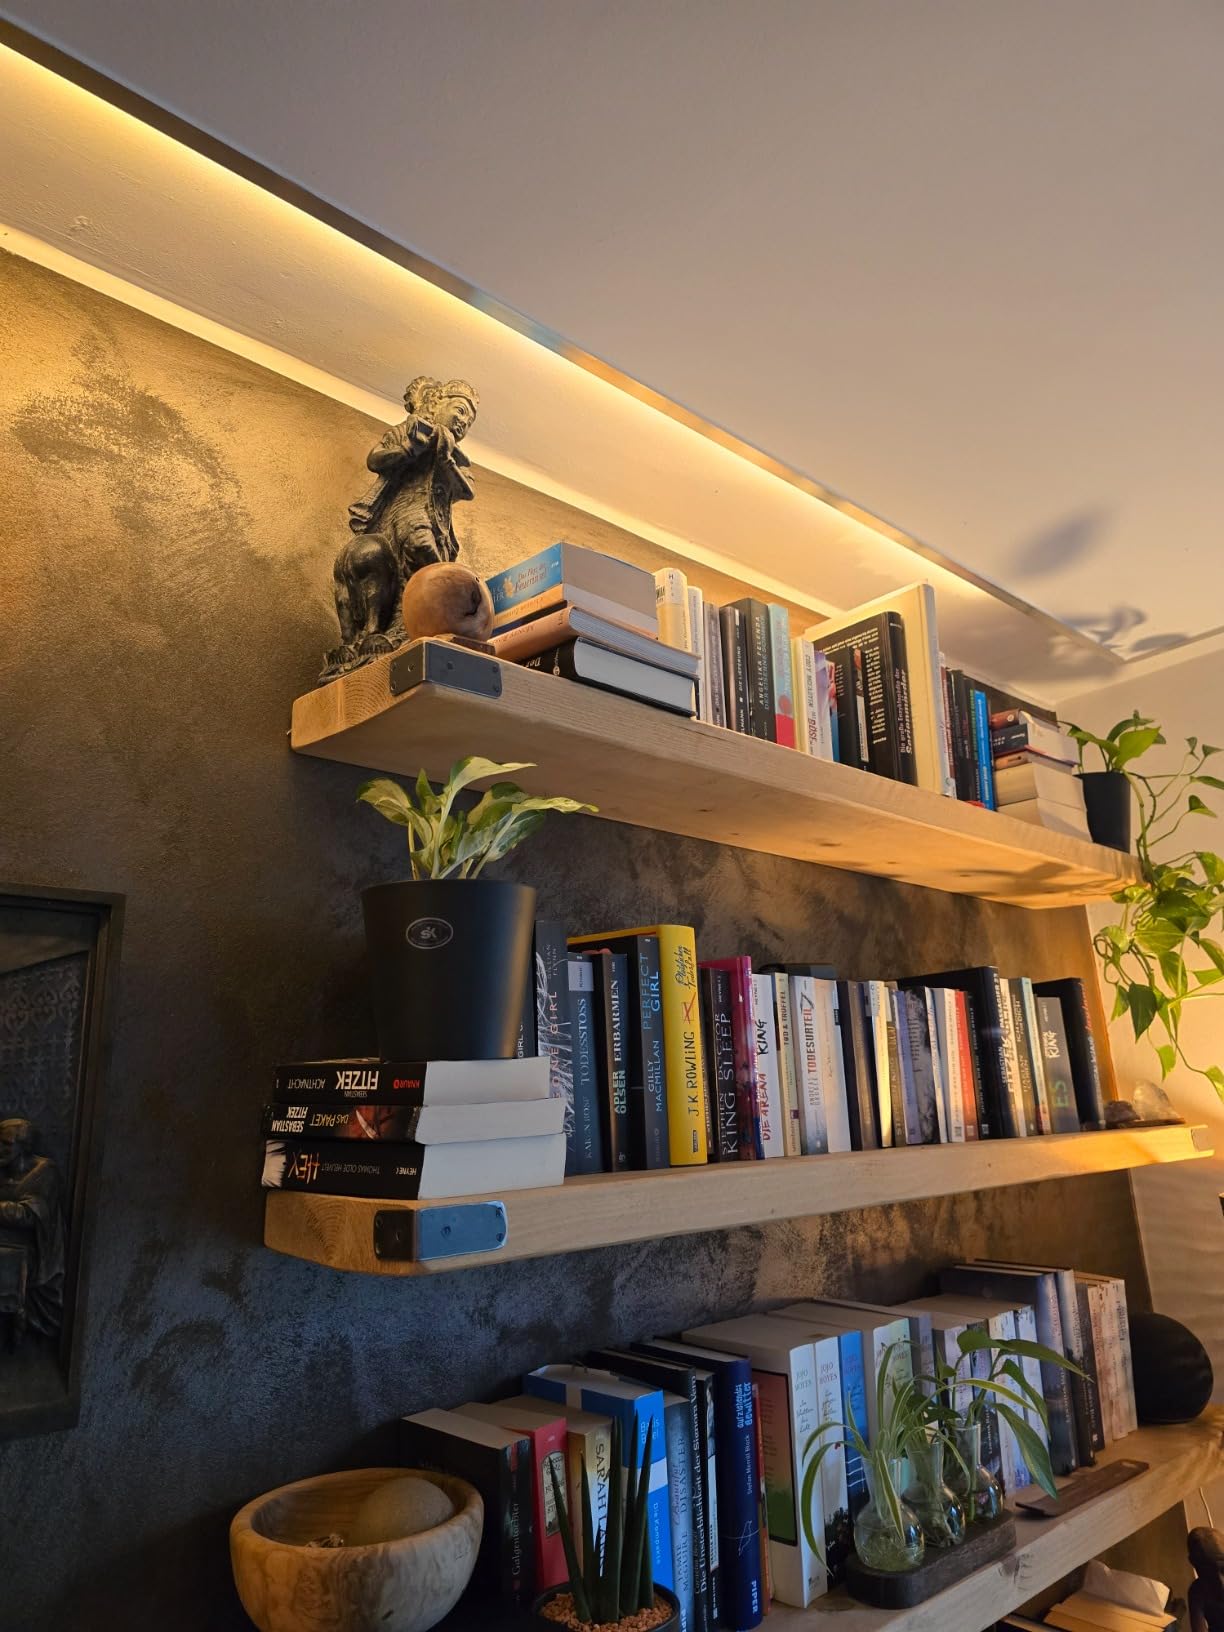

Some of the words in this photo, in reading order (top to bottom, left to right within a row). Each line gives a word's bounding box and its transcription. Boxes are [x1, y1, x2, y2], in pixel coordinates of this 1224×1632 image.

[756, 660, 764, 705] ANGELIKA
[901, 669, 912, 754] Serienmörder
[548, 991, 559, 1034] GIRL
[639, 952, 652, 1030] PERFECT
[650, 971, 660, 1012] GIRL
[994, 984, 1005, 1028] PASSAGIER
[577, 998, 590, 1085] TODESSTOSS
[610, 980, 622, 1061] ERBARMEN
[755, 1019, 769, 1055] KING
[803, 1008, 817, 1074] TODESURTEIL
[715, 1013, 724, 1080] DOCTOR
[720, 1013, 734, 1081] SLEEP
[997, 1046, 1006, 1084] SEBASTIAN
[1046, 1031, 1060, 1058] KING
[287, 1078, 325, 1089] ACHTNACHT
[335, 1070, 380, 1090] FITZEK
[618, 1070, 626, 1114] OLSEN
[647, 1061, 655, 1092] GILLY
[652, 1039, 663, 1112] MACMILLAN
[1049, 1080, 1070, 1108] ES
[271, 1120, 304, 1133] SEBASTIAN
[287, 1107, 308, 1118] FITZEK
[309, 1113, 336, 1127] PAKET
[335, 1114, 349, 1124] DAS
[719, 1092, 727, 1156] STEPHEN
[724, 1092, 739, 1154] KING
[288, 1152, 320, 1184] HEX
[358, 1164, 380, 1174] THOMAS
[691, 1405, 701, 1451] Signora
[596, 1443, 606, 1509] SARAH
[676, 1437, 688, 1513] DISASTER
[693, 1453, 701, 1473] der
[692, 1476, 706, 1568] Unsterblichkeit
[699, 1570, 708, 1592] Die
